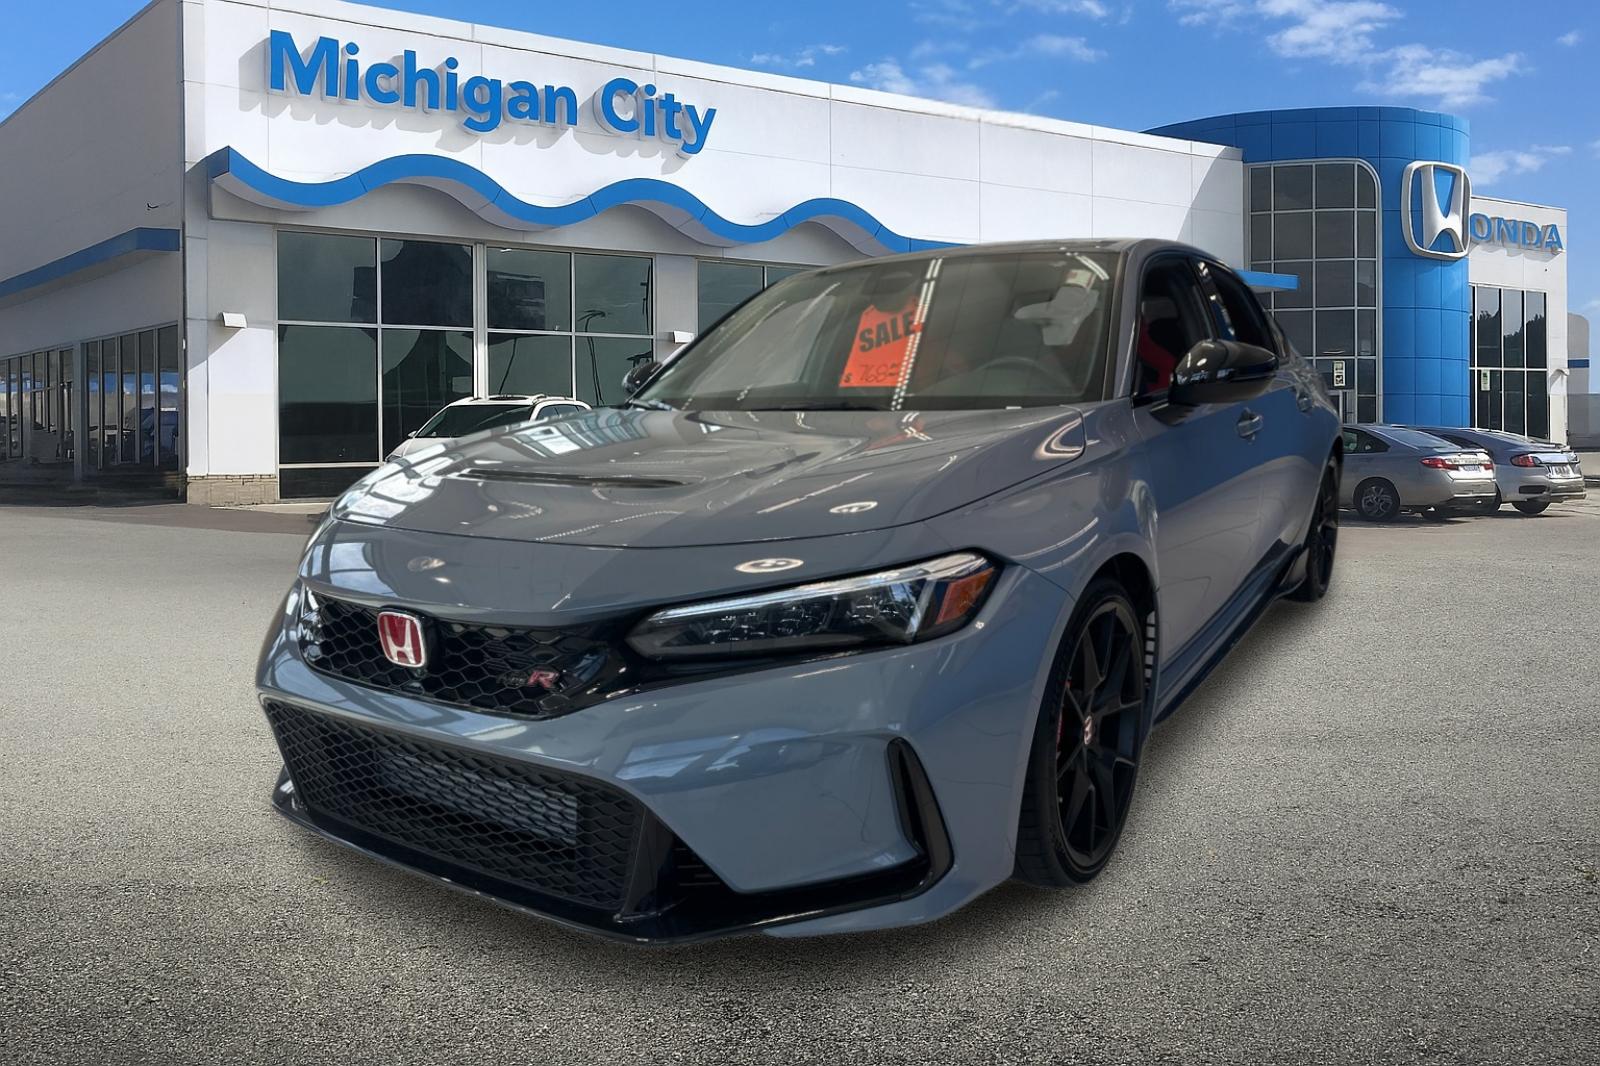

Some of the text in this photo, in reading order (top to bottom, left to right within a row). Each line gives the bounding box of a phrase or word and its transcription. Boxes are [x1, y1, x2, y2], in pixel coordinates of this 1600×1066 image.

[269, 29, 718, 155] Michigan City
[1469, 212, 1564, 251] ONDA
[859, 311, 915, 352] SALE
